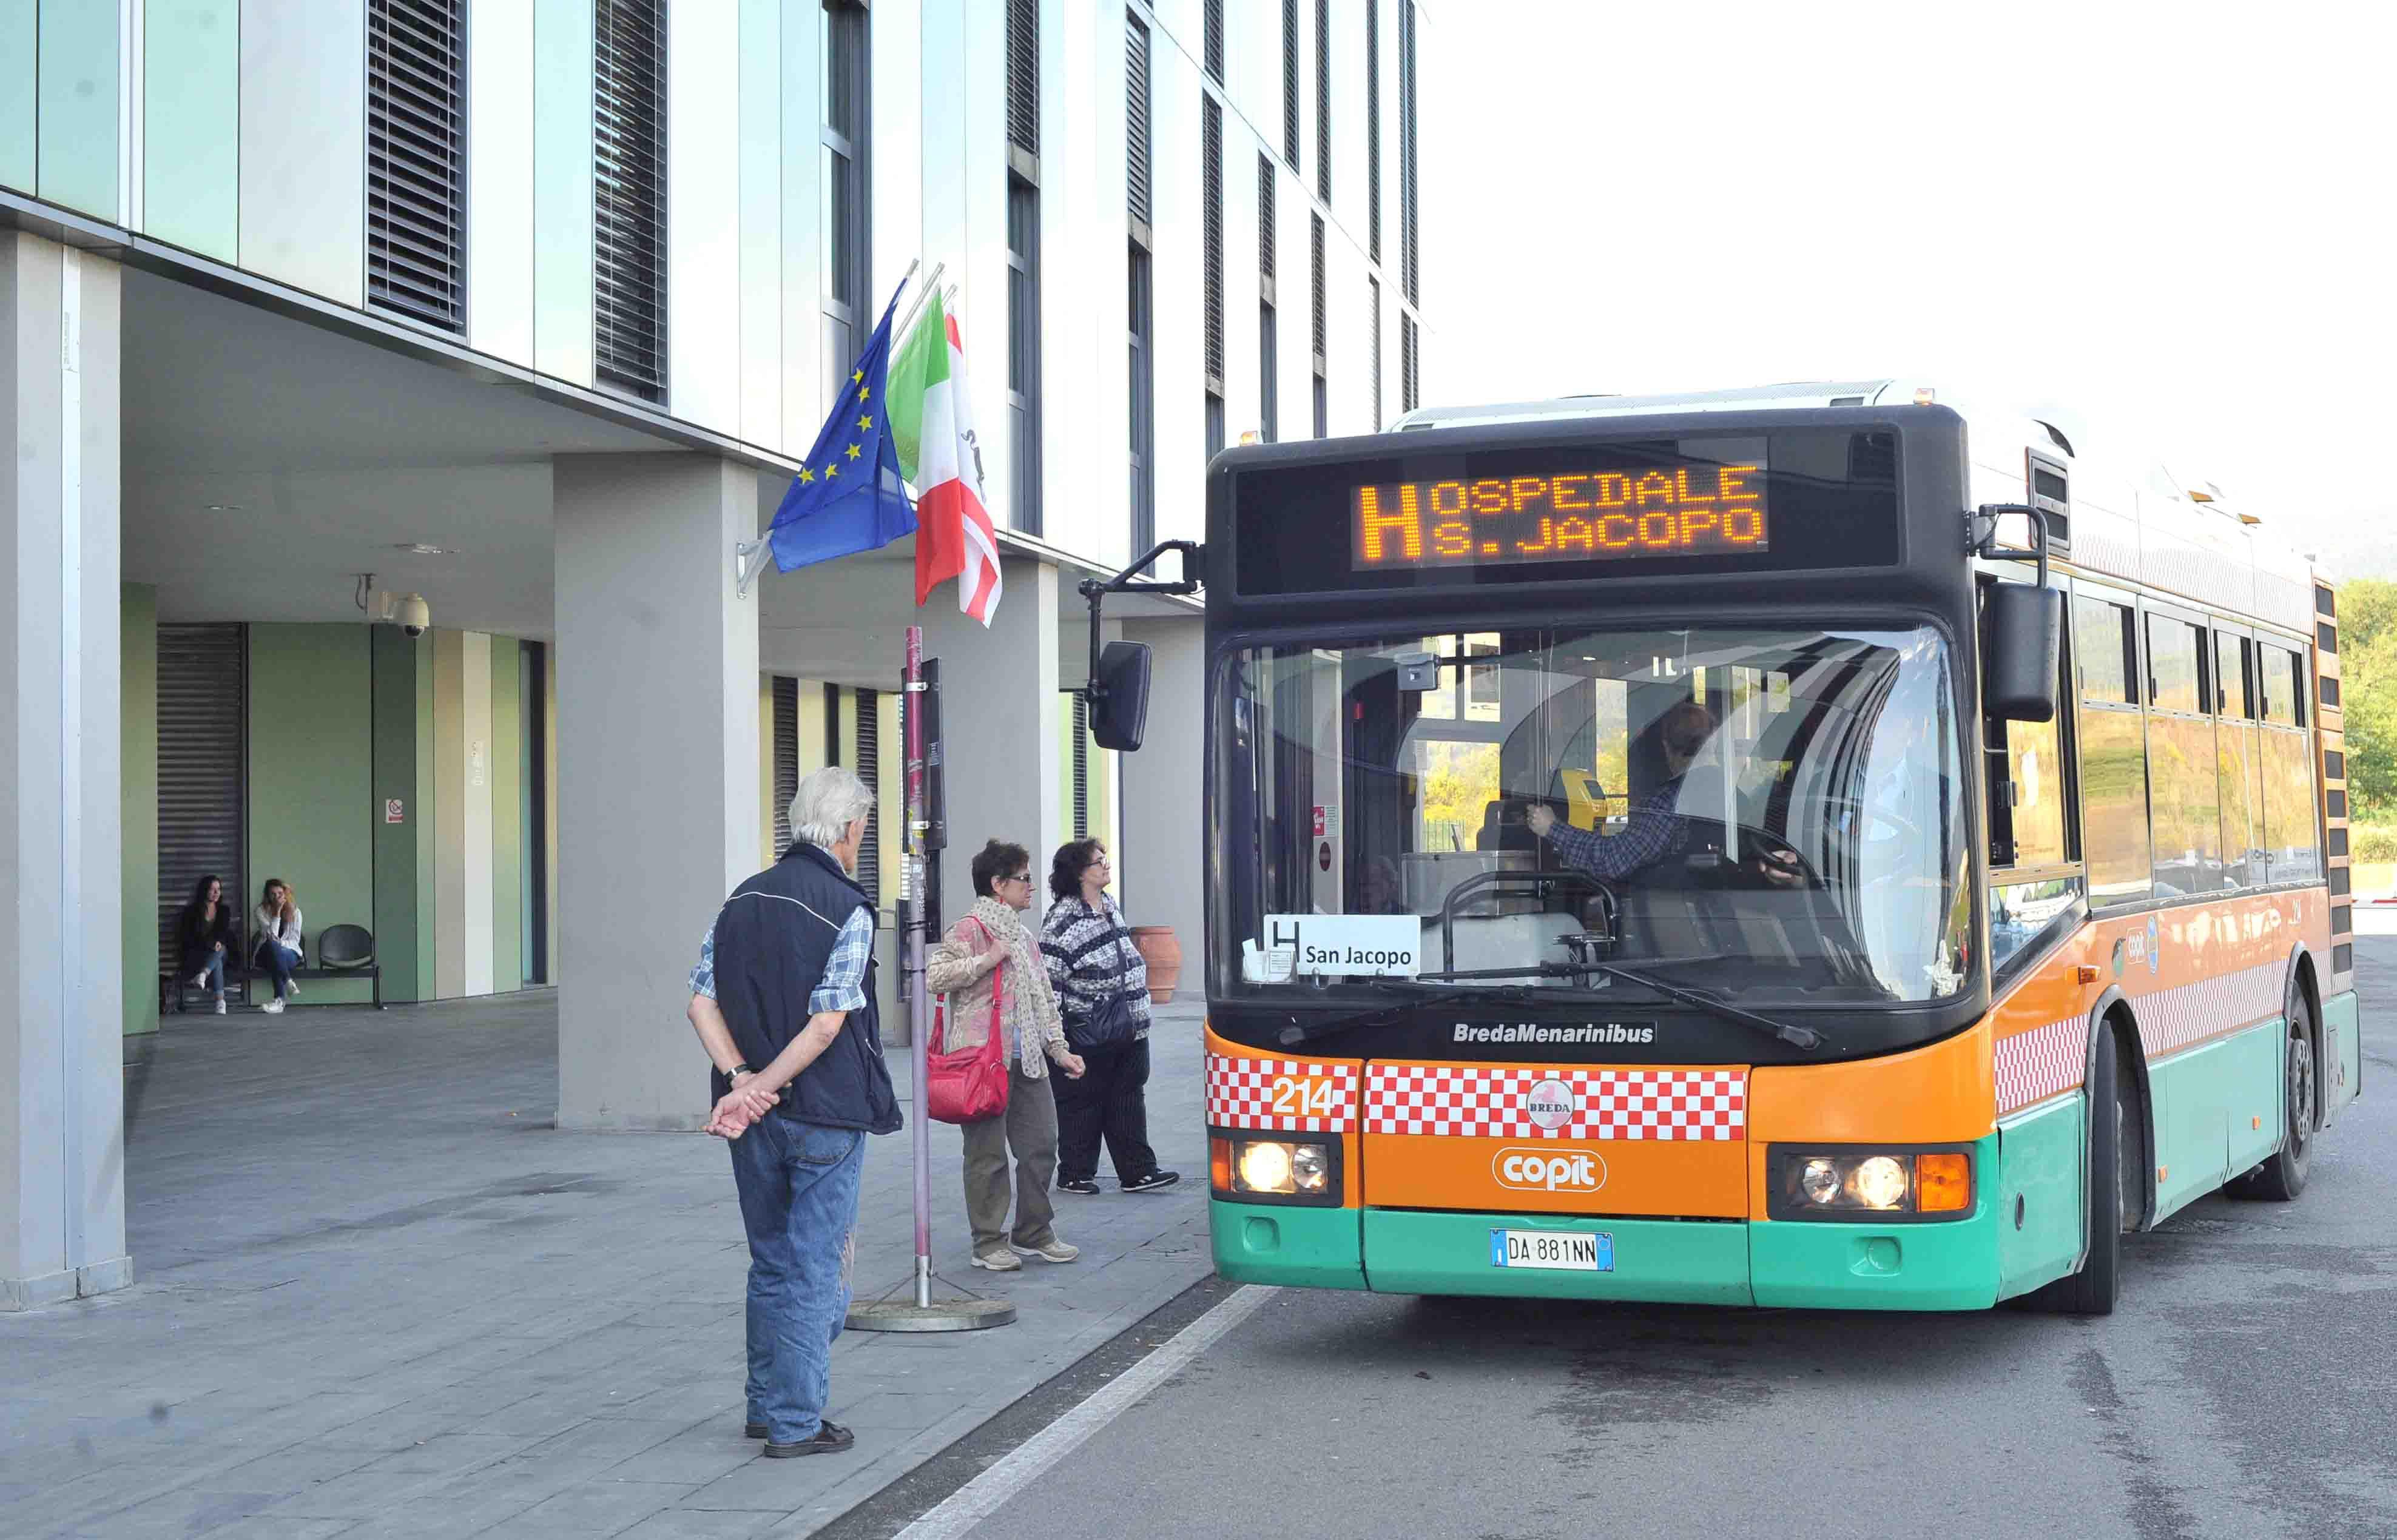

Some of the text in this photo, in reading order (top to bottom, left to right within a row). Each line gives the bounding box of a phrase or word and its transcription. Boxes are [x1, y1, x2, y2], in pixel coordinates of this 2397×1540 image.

[1273, 921, 1300, 963] H
[1306, 945, 1340, 964] San
[1344, 946, 1412, 969] Jacopo
[1453, 1023, 1654, 1044] BredaMenarinibus
[1272, 1077, 1335, 1116] 214
[1529, 1102, 1571, 1114] BREDA
[1503, 1154, 1596, 1192] copit
